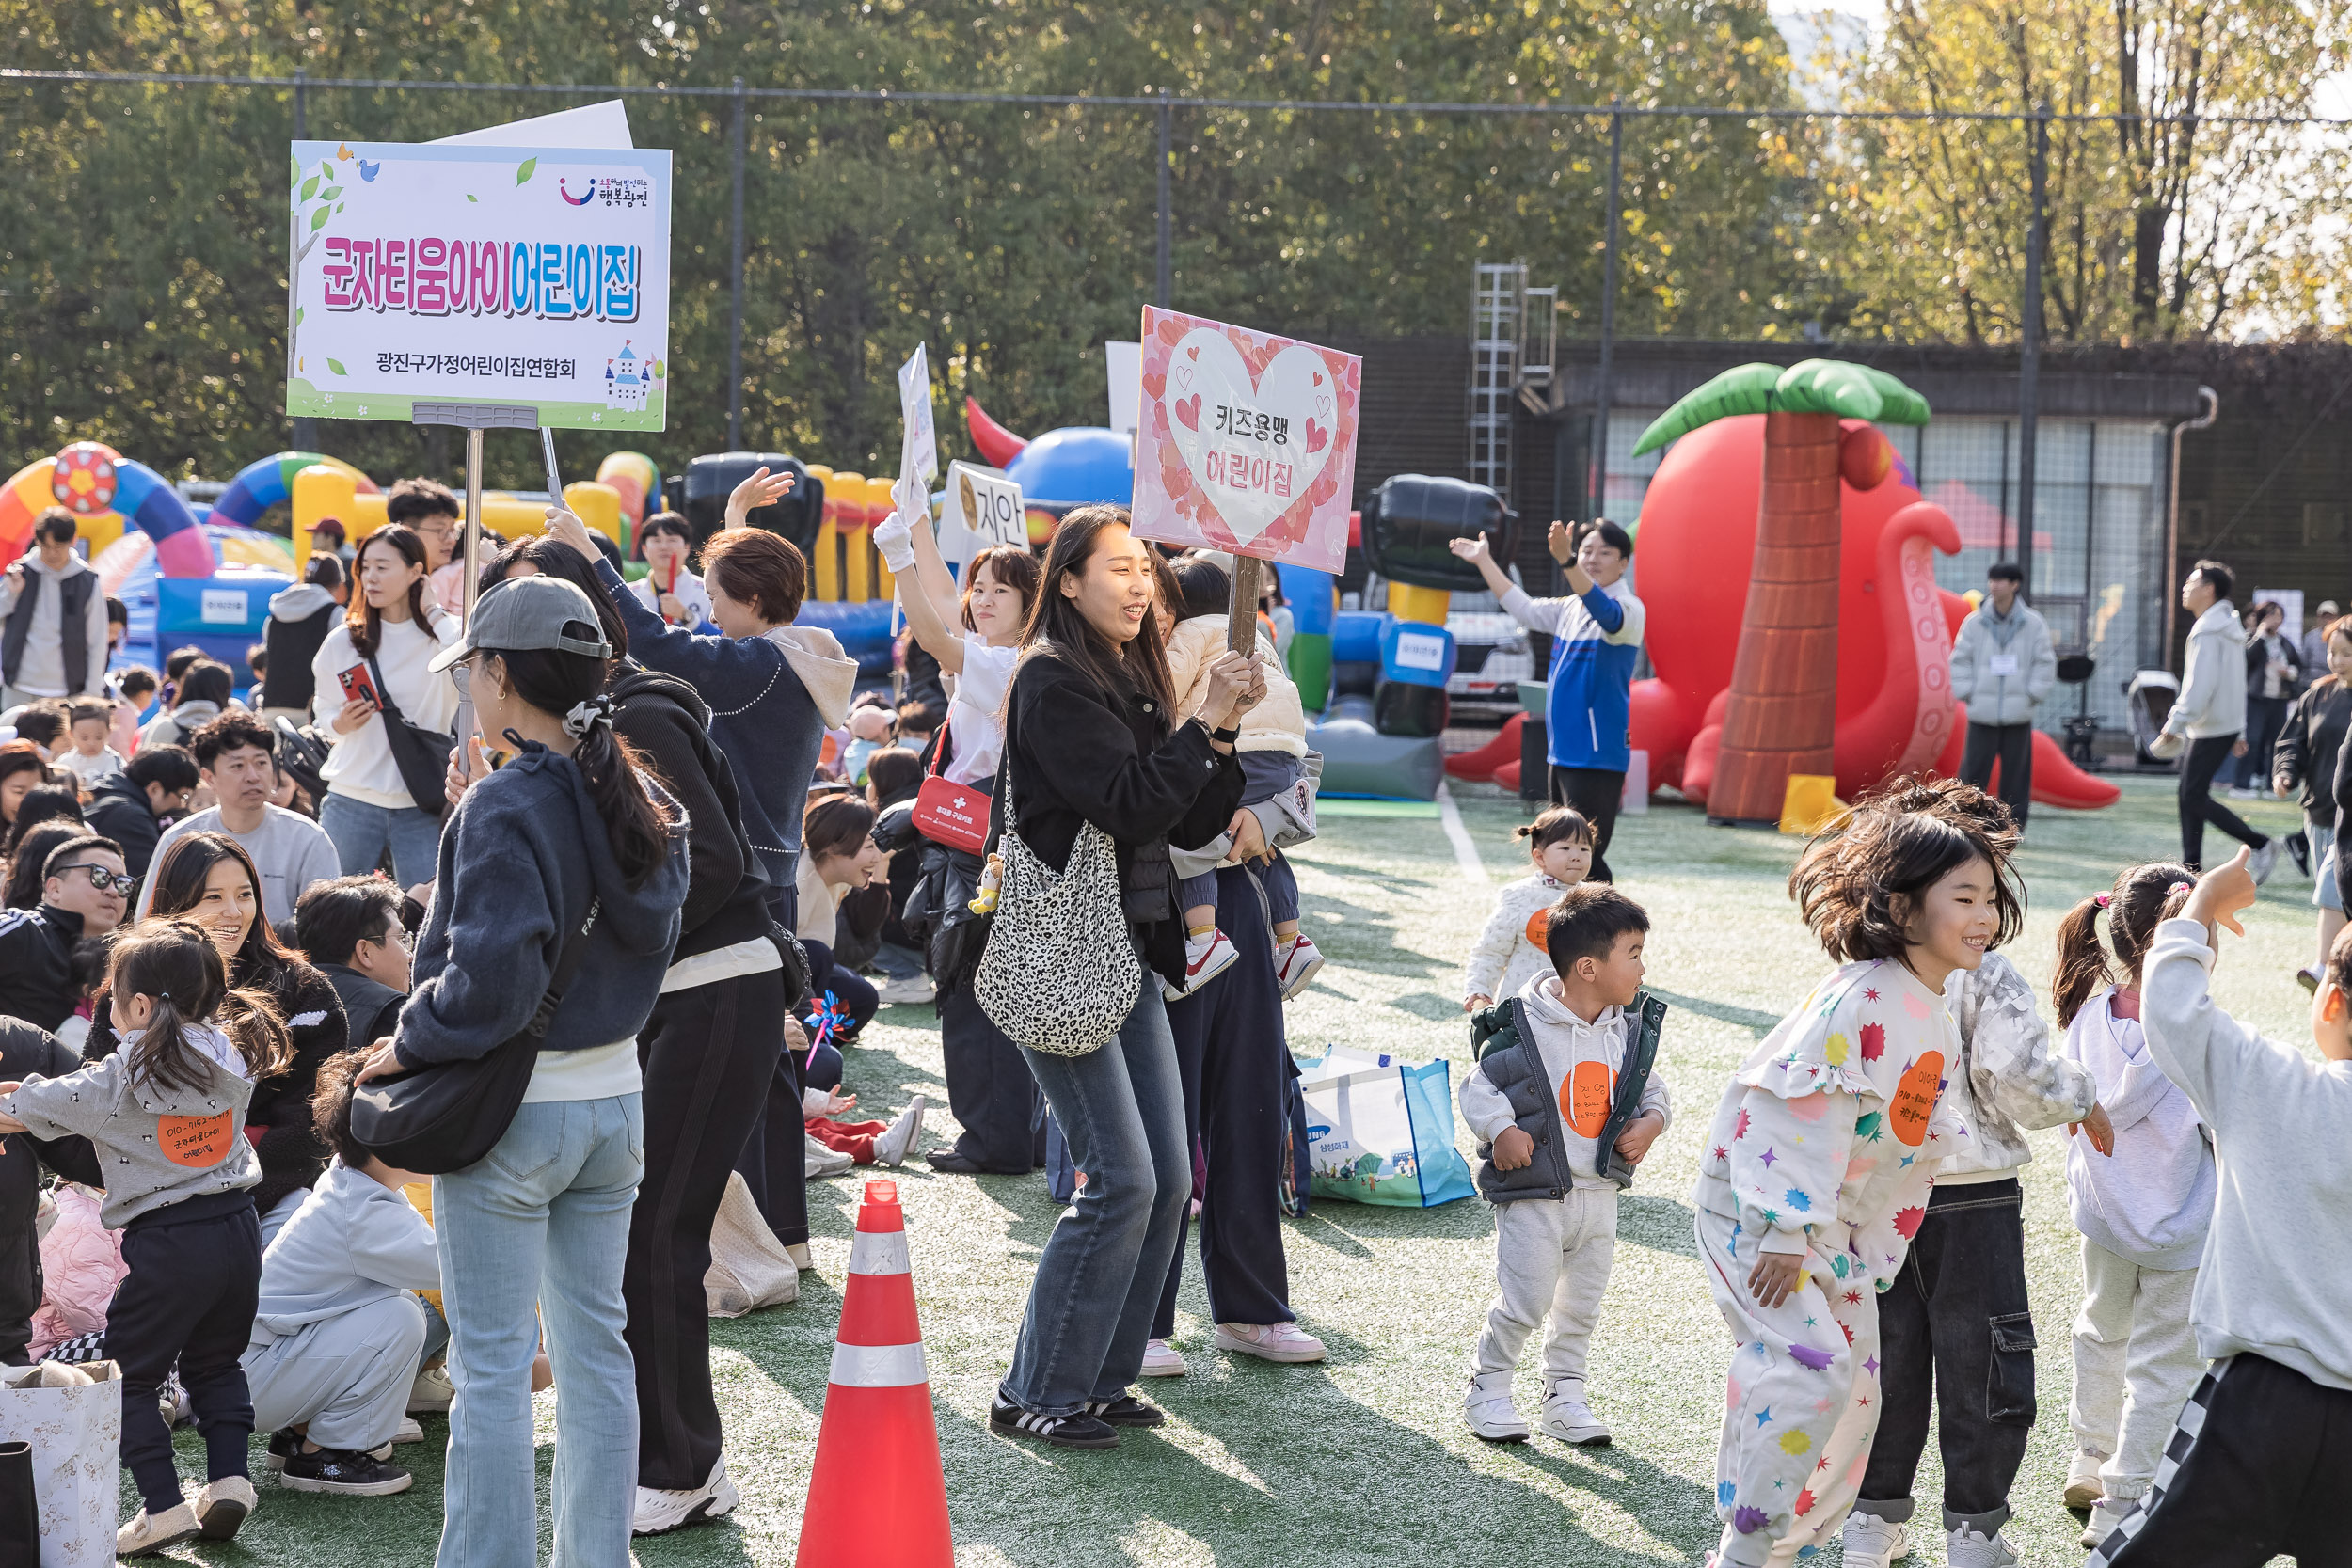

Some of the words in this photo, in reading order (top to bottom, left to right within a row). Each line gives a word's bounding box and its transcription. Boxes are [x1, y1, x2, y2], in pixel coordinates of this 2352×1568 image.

[599, 178, 623, 189] 소통하여
[623, 179, 647, 190] 발전하는
[599, 188, 647, 208] 행복광진
[376, 352, 576, 380] 광진구가정어린이집연합회
[1216, 404, 1290, 446] 키즈용맹
[1205, 449, 1293, 498] 어린이집
[977, 484, 1023, 548] 지안
[1320, 1141, 1349, 1152] 삼성화재
